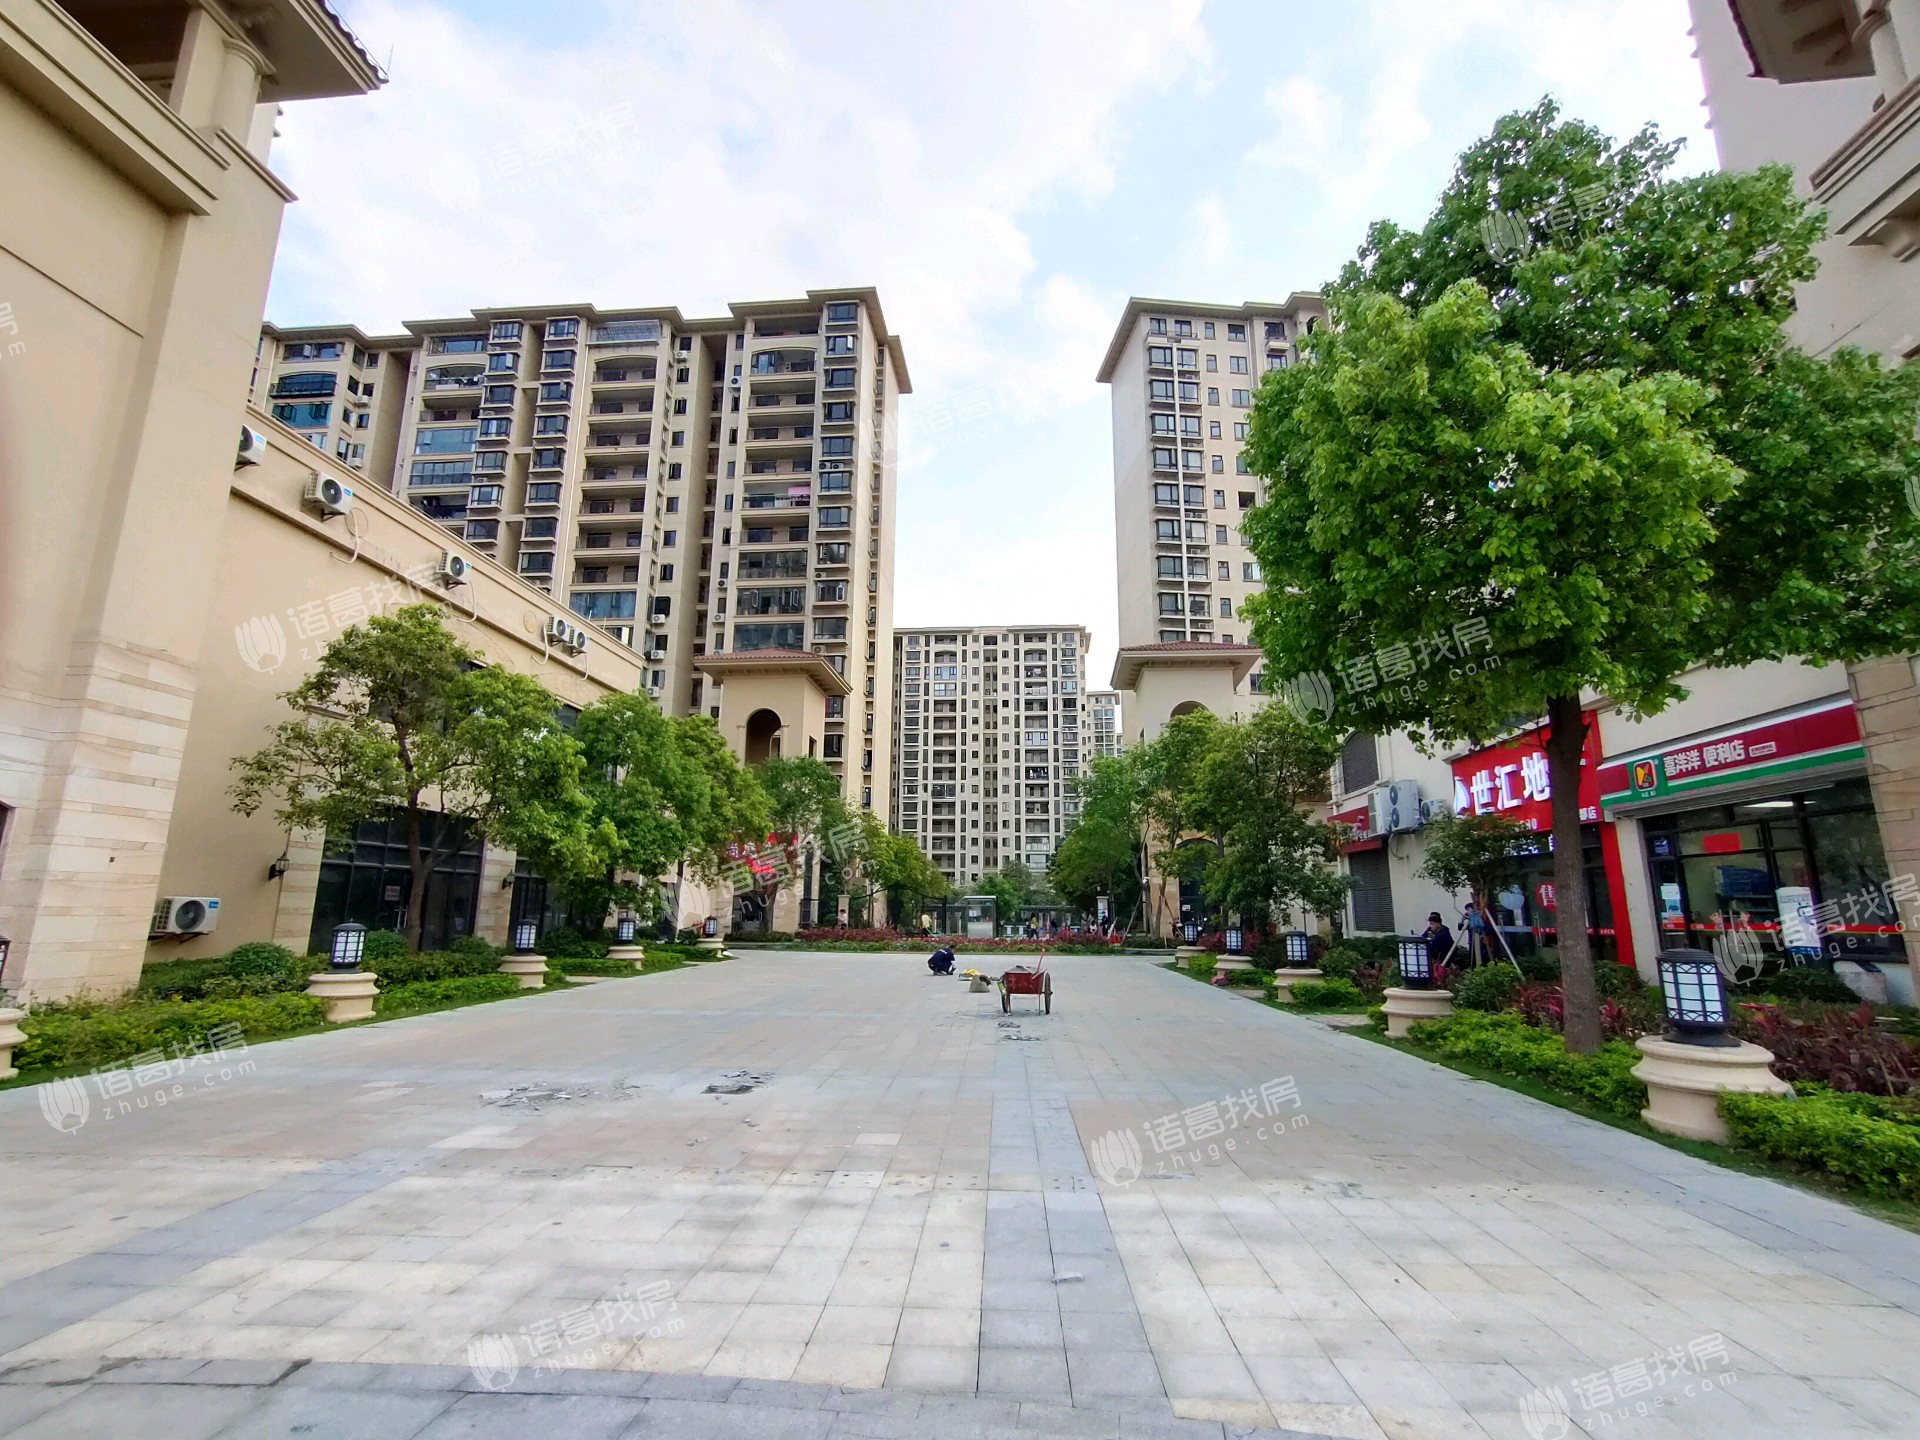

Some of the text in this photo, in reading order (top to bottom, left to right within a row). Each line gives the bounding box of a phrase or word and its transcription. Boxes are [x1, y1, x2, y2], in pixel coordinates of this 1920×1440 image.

[1663, 749, 1701, 776] 喜洋洋
[1703, 740, 1745, 768] 便利店
